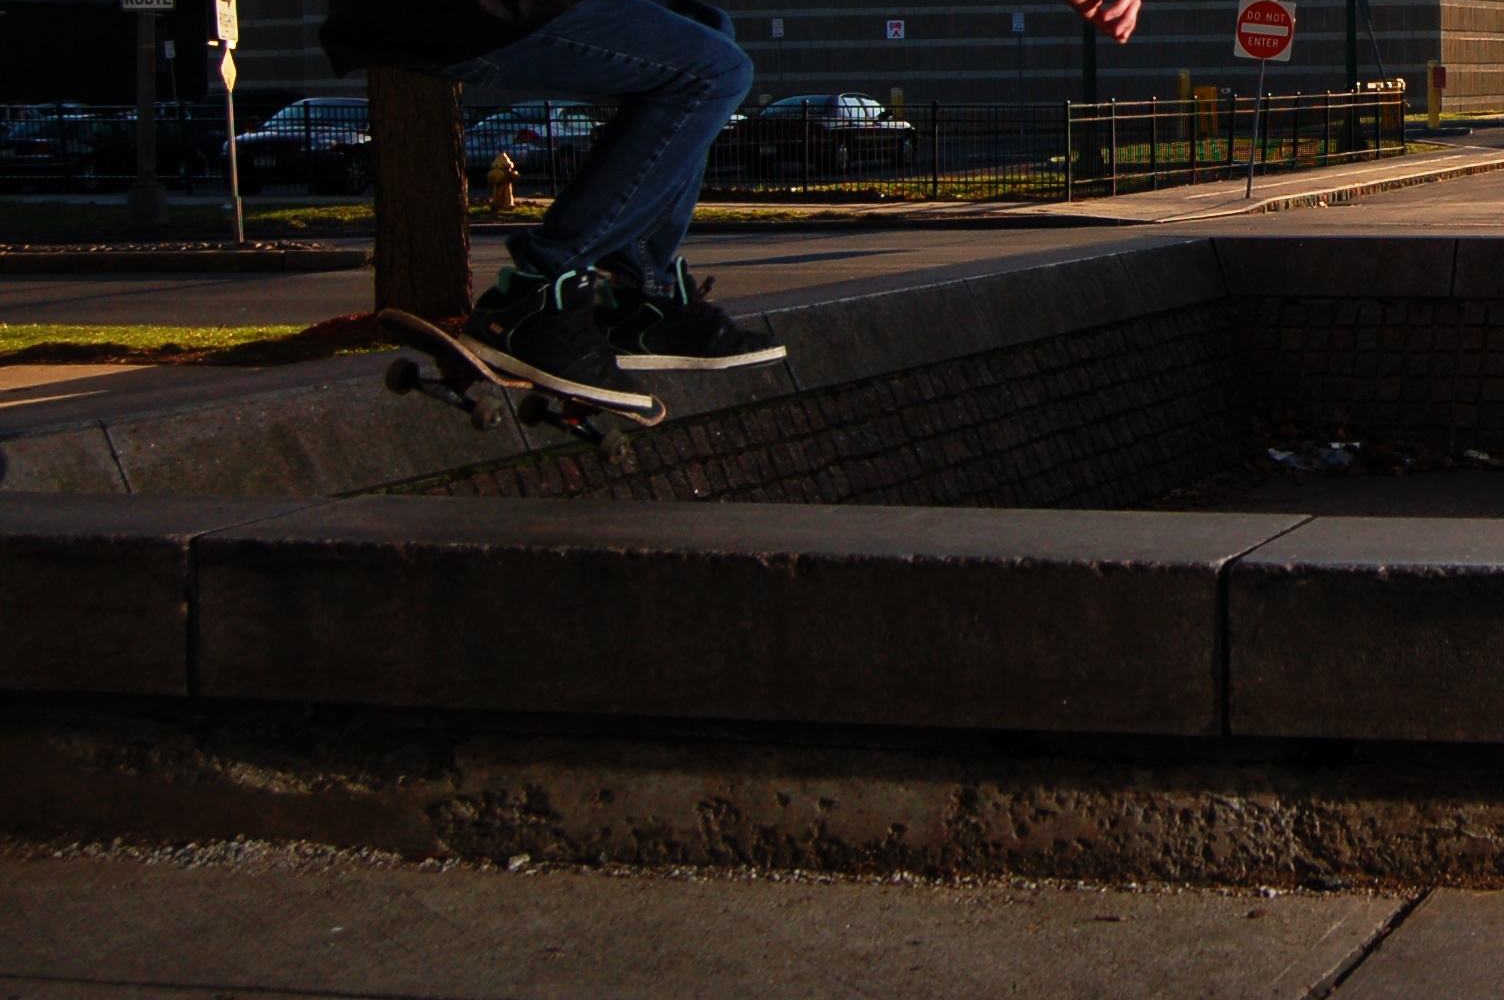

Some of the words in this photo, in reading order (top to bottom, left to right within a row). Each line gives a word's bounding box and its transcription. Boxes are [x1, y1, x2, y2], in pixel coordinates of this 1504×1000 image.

[1247, 10, 1260, 21] DO
[1266, 12, 1286, 23] NOT
[1247, 36, 1279, 47] ENTER
